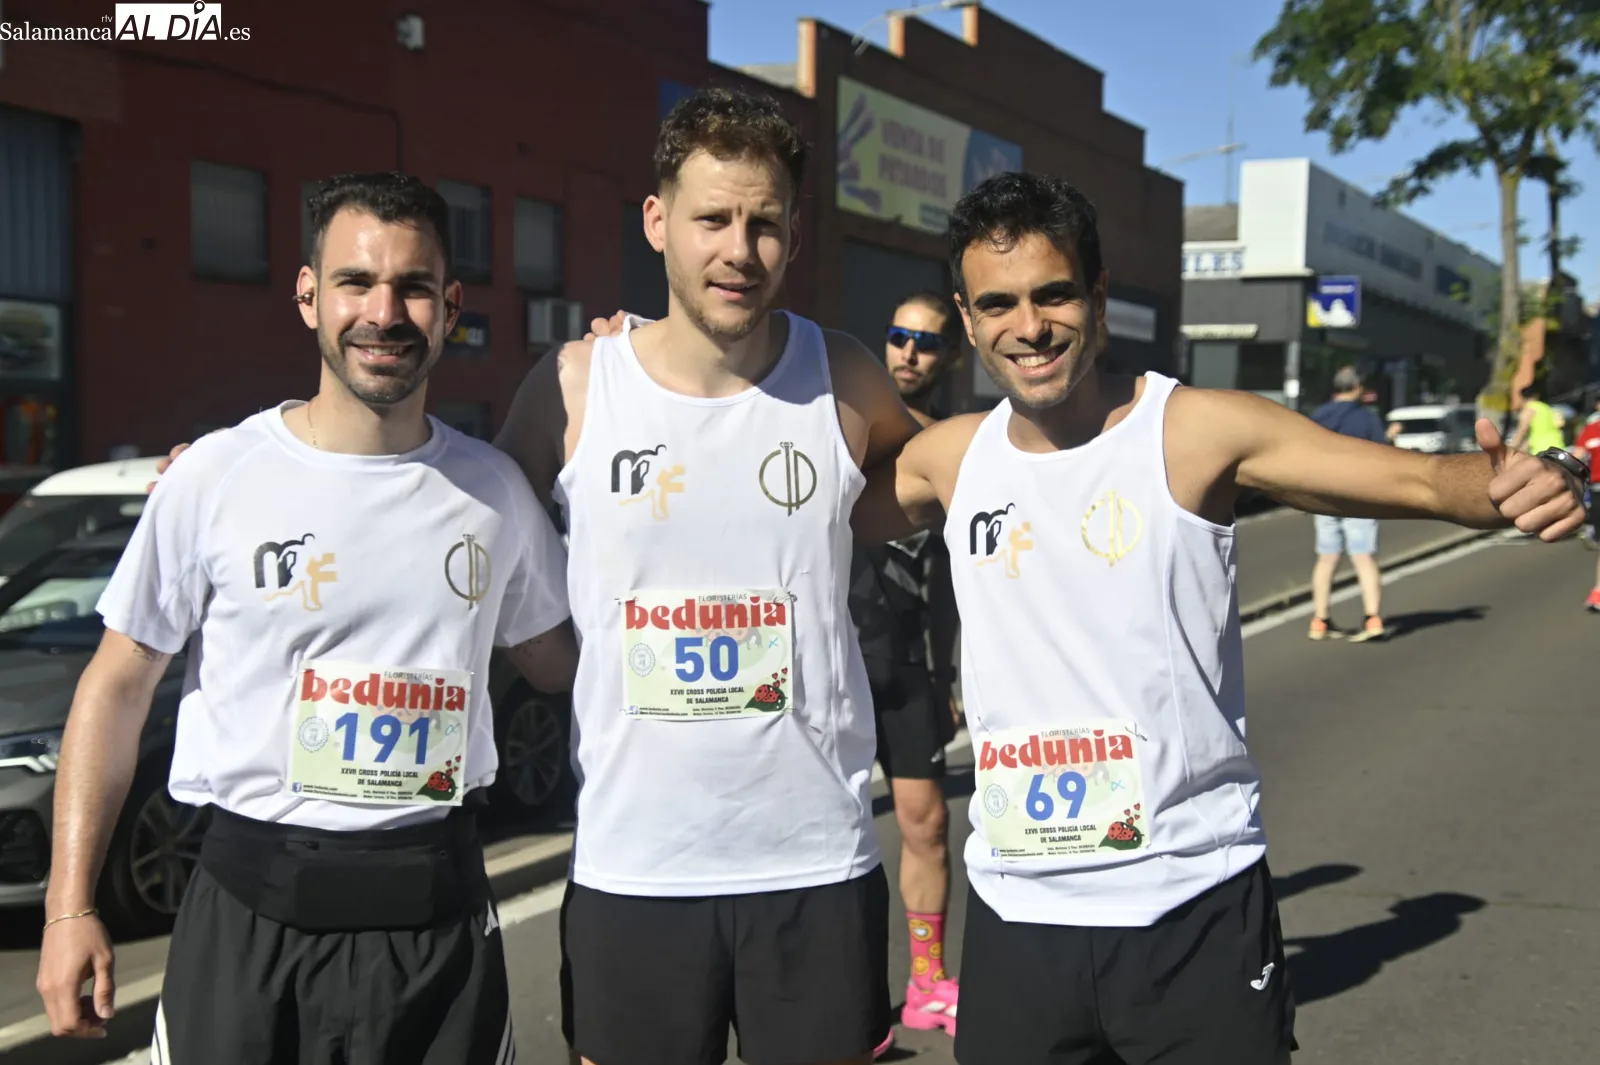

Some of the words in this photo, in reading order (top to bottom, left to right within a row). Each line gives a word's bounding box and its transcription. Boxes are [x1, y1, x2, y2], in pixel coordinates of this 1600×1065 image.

[625, 596, 787, 631] bedunia
[675, 635, 739, 683] 50
[300, 668, 467, 711] bedunia
[686, 688, 704, 696] CROSS
[705, 687, 727, 695] POLICÍA
[695, 697, 729, 705] SALAMANCA
[335, 712, 430, 765] 191
[979, 729, 1134, 771] bedunia
[357, 778, 365, 786] DE
[367, 779, 403, 787] SALAMANCA
[358, 768, 378, 777] CROSS
[380, 768, 402, 778] POLICÍA
[402, 770, 419, 779] LOCAL
[1025, 771, 1087, 821] 69
[1040, 826, 1057, 834] CROSS
[1049, 835, 1081, 843] SALAMANCA
